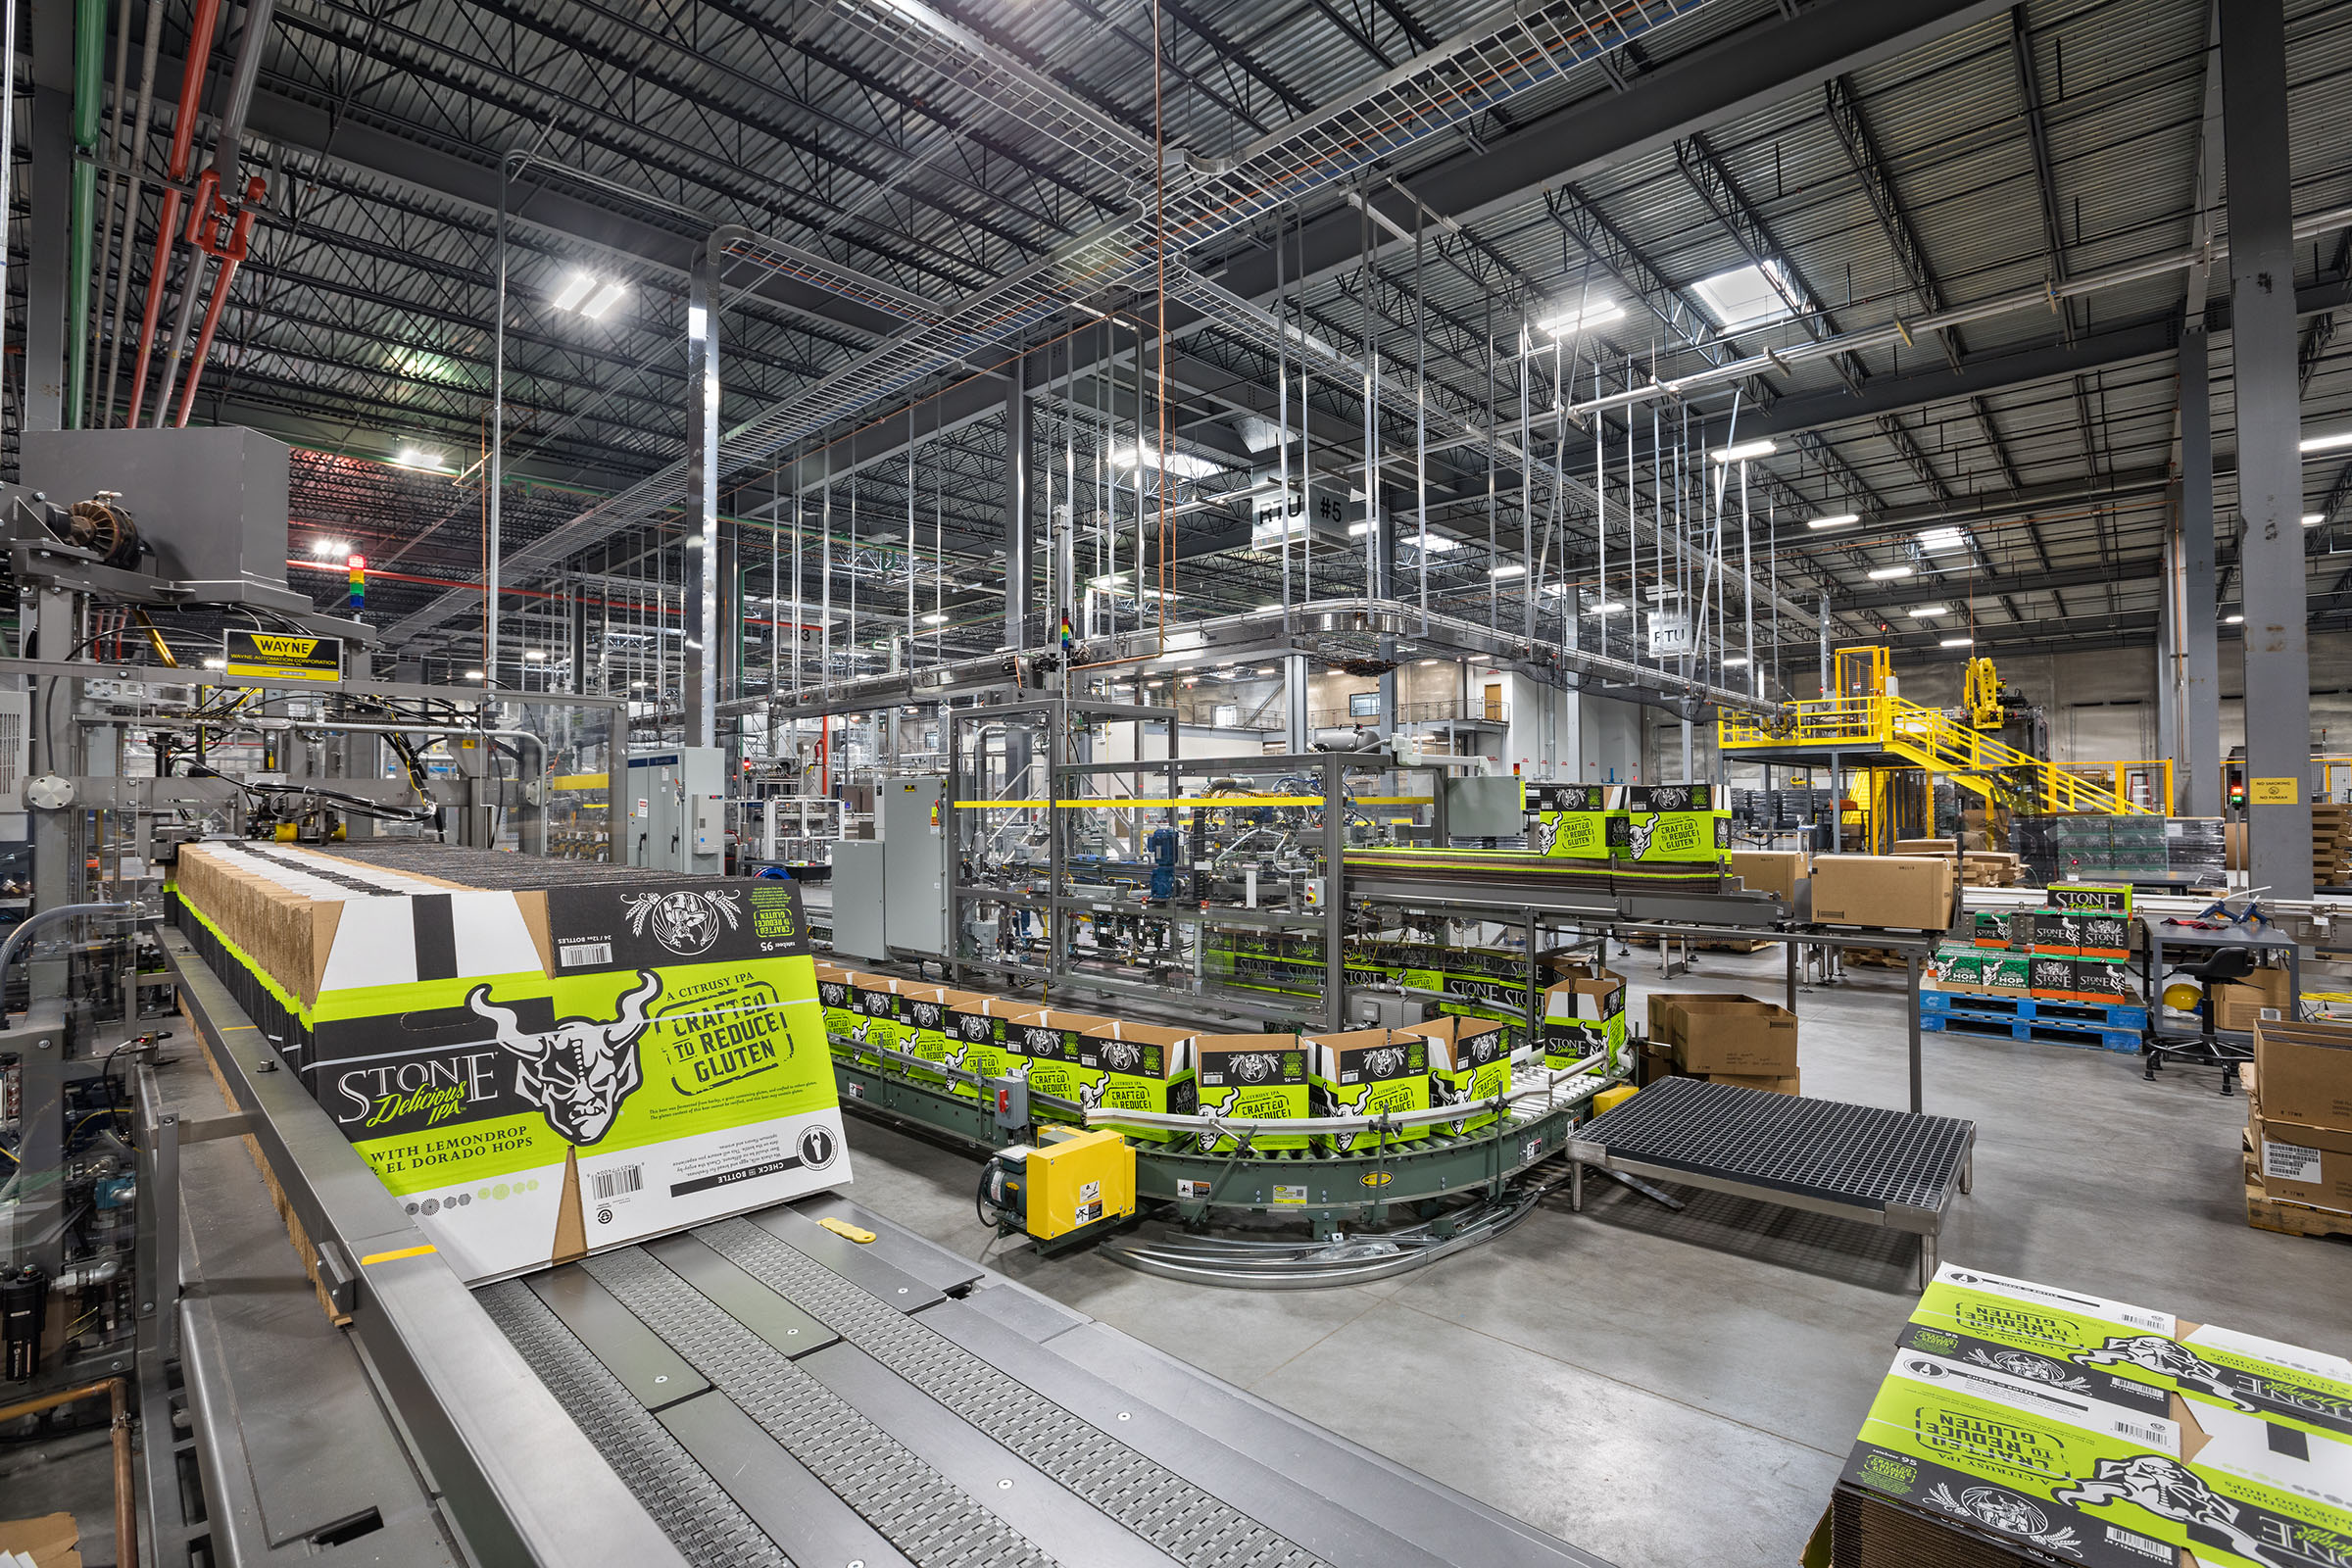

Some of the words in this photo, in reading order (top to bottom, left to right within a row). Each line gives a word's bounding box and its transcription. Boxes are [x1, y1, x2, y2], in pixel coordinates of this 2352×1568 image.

[1259, 495, 1300, 524] RTU
[1320, 496, 1342, 522] #5
[260, 639, 310, 654] WAYNE
[1563, 823, 1590, 833] CRAFTED
[1570, 829, 1592, 838] REDUCE
[1661, 823, 1693, 834] CRAFTED
[1669, 830, 1696, 840] REDUCE
[1568, 837, 1590, 846] GLUTEN
[1666, 839, 1693, 849] GLUTEN
[2055, 892, 2117, 909] STONE
[2036, 927, 2066, 938] STONE
[2085, 933, 2124, 946] STONE
[760, 942, 773, 951] 95
[1245, 936, 1270, 951] STONE
[1293, 941, 1319, 956] STONE
[666, 992, 676, 1002] A
[678, 977, 731, 998] CITRUSY
[735, 971, 755, 983] IPA
[2034, 974, 2072, 988] STONE
[2080, 975, 2110, 987] STONE
[671, 992, 768, 1036] CRAFTED
[674, 1042, 695, 1059] TO
[699, 1012, 780, 1054] REDUCE
[920, 1043, 944, 1052] CRAFTED
[1548, 1037, 1586, 1054] STONE
[694, 1039, 776, 1083] GLUTEN
[1035, 1074, 1065, 1084] CRAFTED
[1477, 1074, 1499, 1094] CRAFTED
[338, 1052, 499, 1123] STONE
[1043, 1084, 1067, 1093] REDUCE
[1111, 1090, 1146, 1101] CRAFTED
[1374, 1092, 1408, 1111] CRAFTED
[366, 1081, 467, 1127] Delicious
[1120, 1100, 1149, 1109] REDUCE
[1242, 1100, 1284, 1115] CRAFTED
[426, 1100, 462, 1126] IPA
[369, 1146, 419, 1163] WITH
[425, 1125, 527, 1153] LEMONDROP
[386, 1158, 406, 1174] EL
[412, 1146, 486, 1169] DORADO
[492, 1137, 533, 1153] HOPS
[758, 1162, 784, 1174] CHECK
[717, 1171, 747, 1183] BOTTLE
[1965, 1311, 2044, 1331] REDUCE
[1976, 1306, 2056, 1327] GLUTEN
[1970, 1320, 2066, 1342] CRAFTED
[2004, 1337, 2054, 1349] CITRUSY
[2212, 1357, 2300, 1382] LEMONDROP
[1966, 1374, 1995, 1385] CHECK
[2007, 1385, 2038, 1396] BOTTLE
[1939, 1413, 2036, 1445] GLUTEN
[1927, 1423, 2022, 1453] REDUCE
[1932, 1437, 2050, 1469] CRAFTED
[1938, 1453, 1961, 1462] IPA
[2031, 1448, 2054, 1460] TO
[1901, 1456, 1918, 1466] 95
[1968, 1460, 2034, 1481] CITRUSY
[2224, 1481, 2267, 1498] HOPS
[2229, 1489, 2337, 1527] LEMONDROP
[2137, 1550, 2173, 1566] BOTTLES
